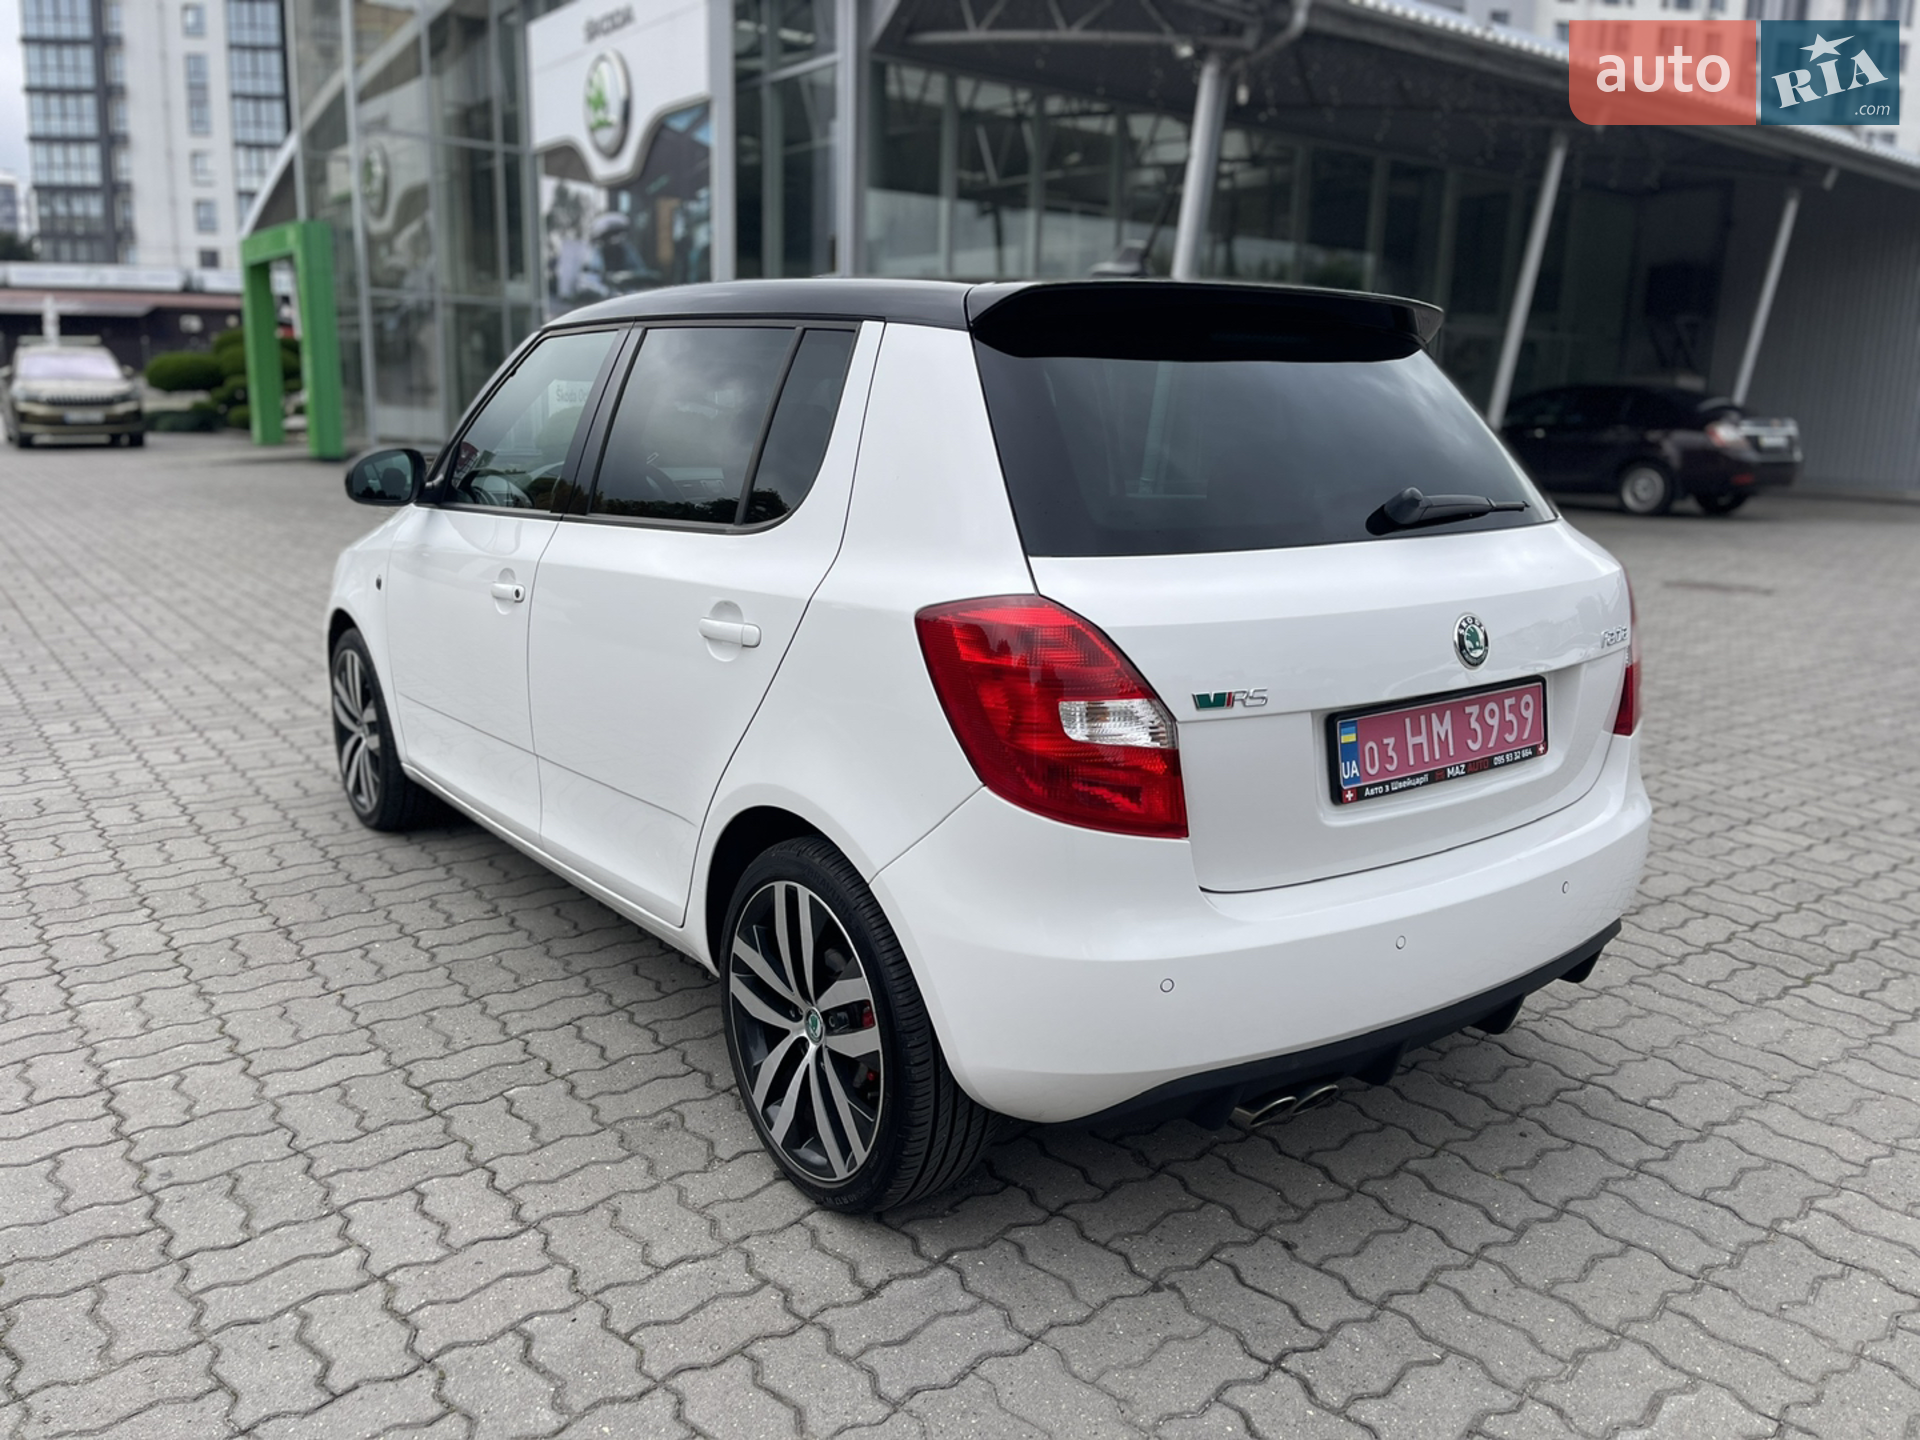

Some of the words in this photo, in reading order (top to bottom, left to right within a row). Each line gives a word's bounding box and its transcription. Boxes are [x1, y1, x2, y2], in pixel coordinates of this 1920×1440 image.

[1341, 761, 1360, 779] UA
[1364, 737, 1398, 775] 03
[1464, 694, 1535, 751] 3959
[1447, 763, 1466, 778] MAZ
[1467, 759, 1489, 773] AUTO
[1364, 786, 1384, 797] Авто
